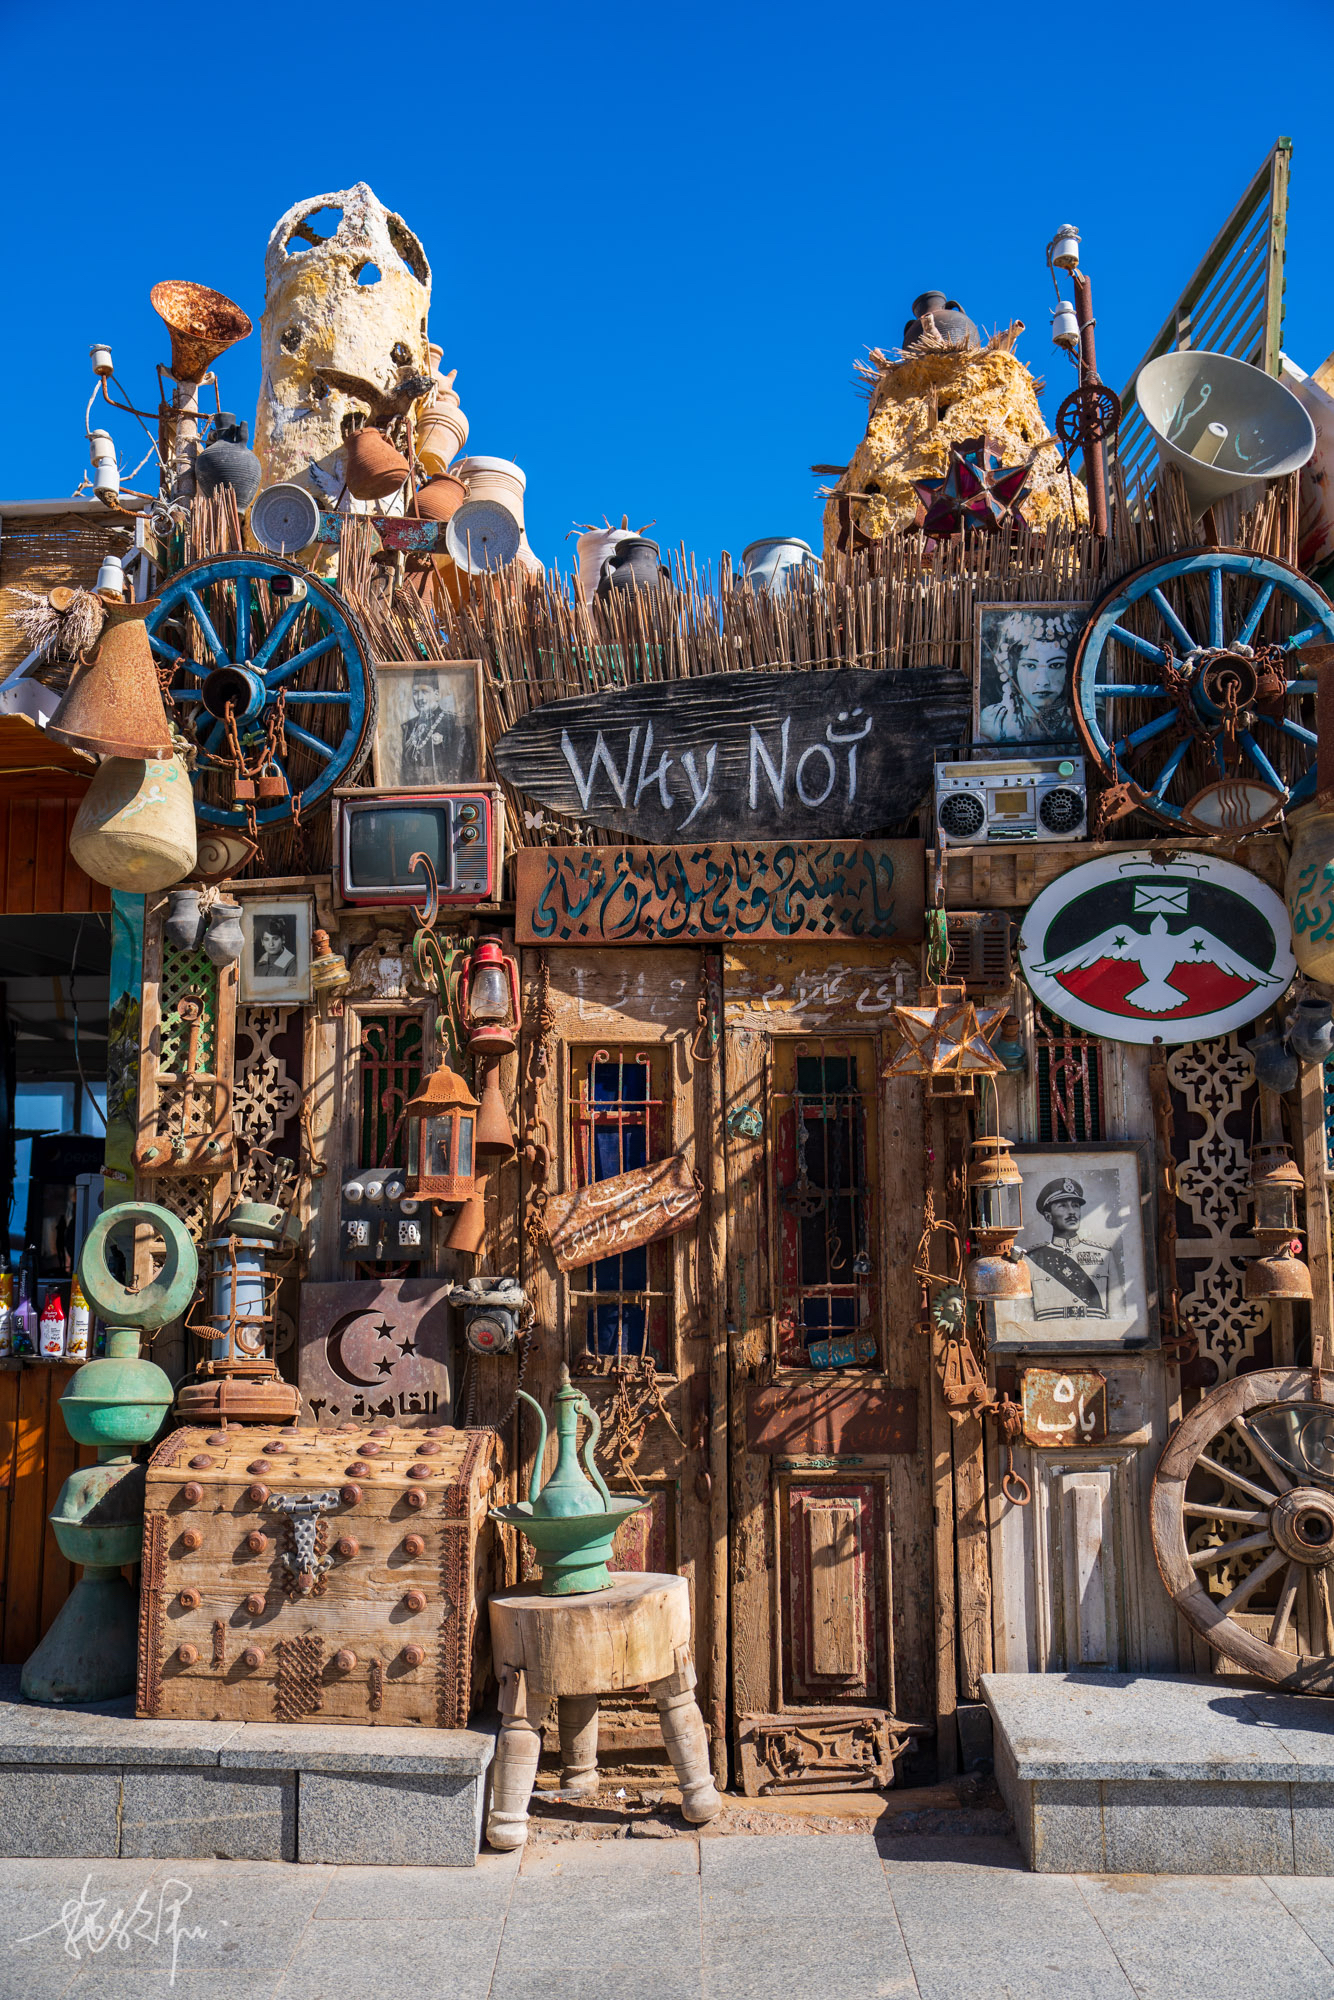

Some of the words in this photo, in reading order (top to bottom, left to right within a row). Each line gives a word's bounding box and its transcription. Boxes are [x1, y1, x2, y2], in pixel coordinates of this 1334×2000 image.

[308, 1397, 341, 1423] ٣٠
[350, 1390, 439, 1424] القاهرة
[1037, 1393, 1096, 1442] باب
